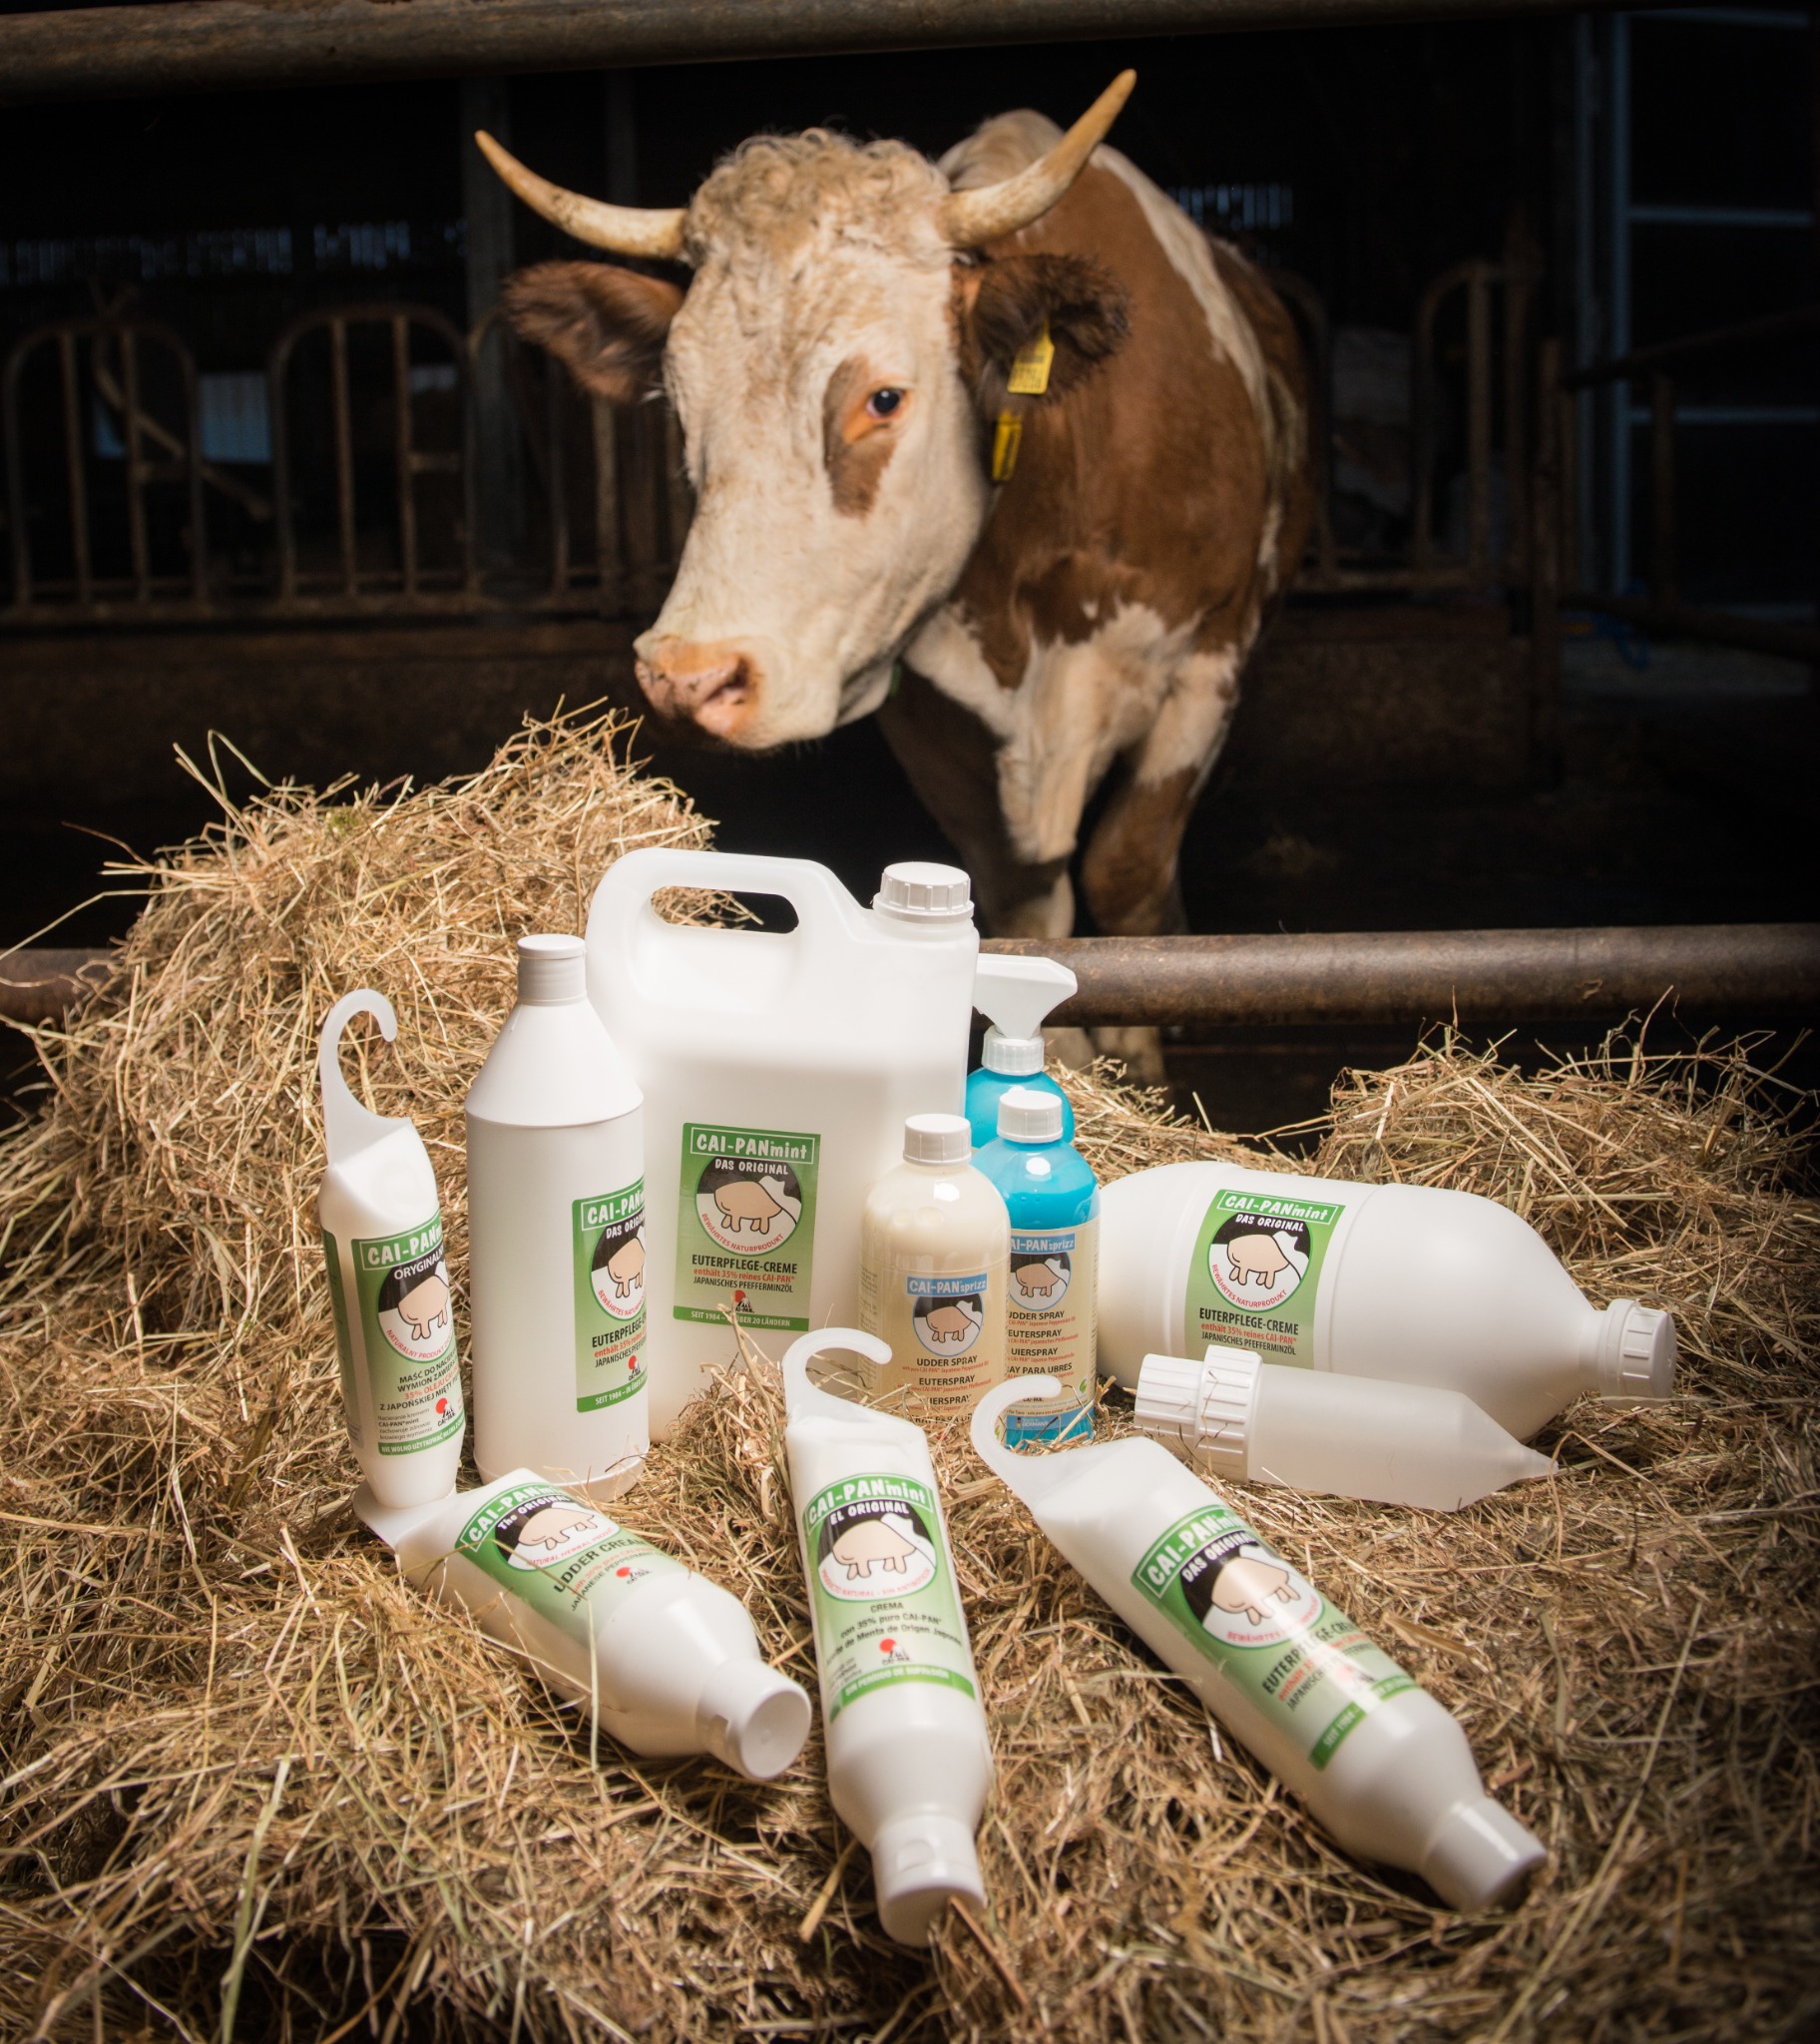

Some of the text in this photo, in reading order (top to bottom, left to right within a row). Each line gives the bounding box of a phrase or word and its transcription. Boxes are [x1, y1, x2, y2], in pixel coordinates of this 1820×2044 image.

[715, 1159, 788, 1175] DAS ORIGINAL
[1235, 1214, 1304, 1232] DAS ORIGINAL
[607, 1225, 622, 1239] DAS
[702, 1214, 783, 1252] BEWÄHRTES NATURPRODUKT
[692, 1255, 797, 1274] EUTERPFLEGE-CREME
[694, 1269, 720, 1278] enthält
[693, 1277, 793, 1292] JAPANISCHES PFEFFERMINZÖL
[1212, 1265, 1287, 1307] BEWÄHRTES NATURPRODUKT
[1039, 1310, 1065, 1319] SPRAY
[1199, 1307, 1298, 1334] EUTERPFLEGE-CREME
[1009, 1329, 1062, 1338] EUTERSPRAY
[1201, 1323, 1226, 1333] enthält
[1244, 1330, 1264, 1339] reines
[1202, 1331, 1296, 1355] JAPANISCHES PFEFFERMINZÖL
[1012, 1347, 1058, 1356] UIERSPRAY
[951, 1355, 978, 1366] SPRAY
[1048, 1362, 1072, 1373] UBRES
[425, 1366, 435, 1376] DO
[398, 1378, 432, 1392] WYMION
[919, 1374, 975, 1385] EUTERSPRAY
[596, 1394, 607, 1405] SEIT
[830, 1500, 909, 1525] EL ORIGINAL
[498, 1514, 518, 1530] The
[554, 1550, 600, 1593] UDDER
[1181, 1557, 1207, 1583] DAS
[870, 1602, 904, 1613] CREMA
[841, 1626, 855, 1639] con
[879, 1615, 900, 1624] puro
[856, 1629, 884, 1641] Menta
